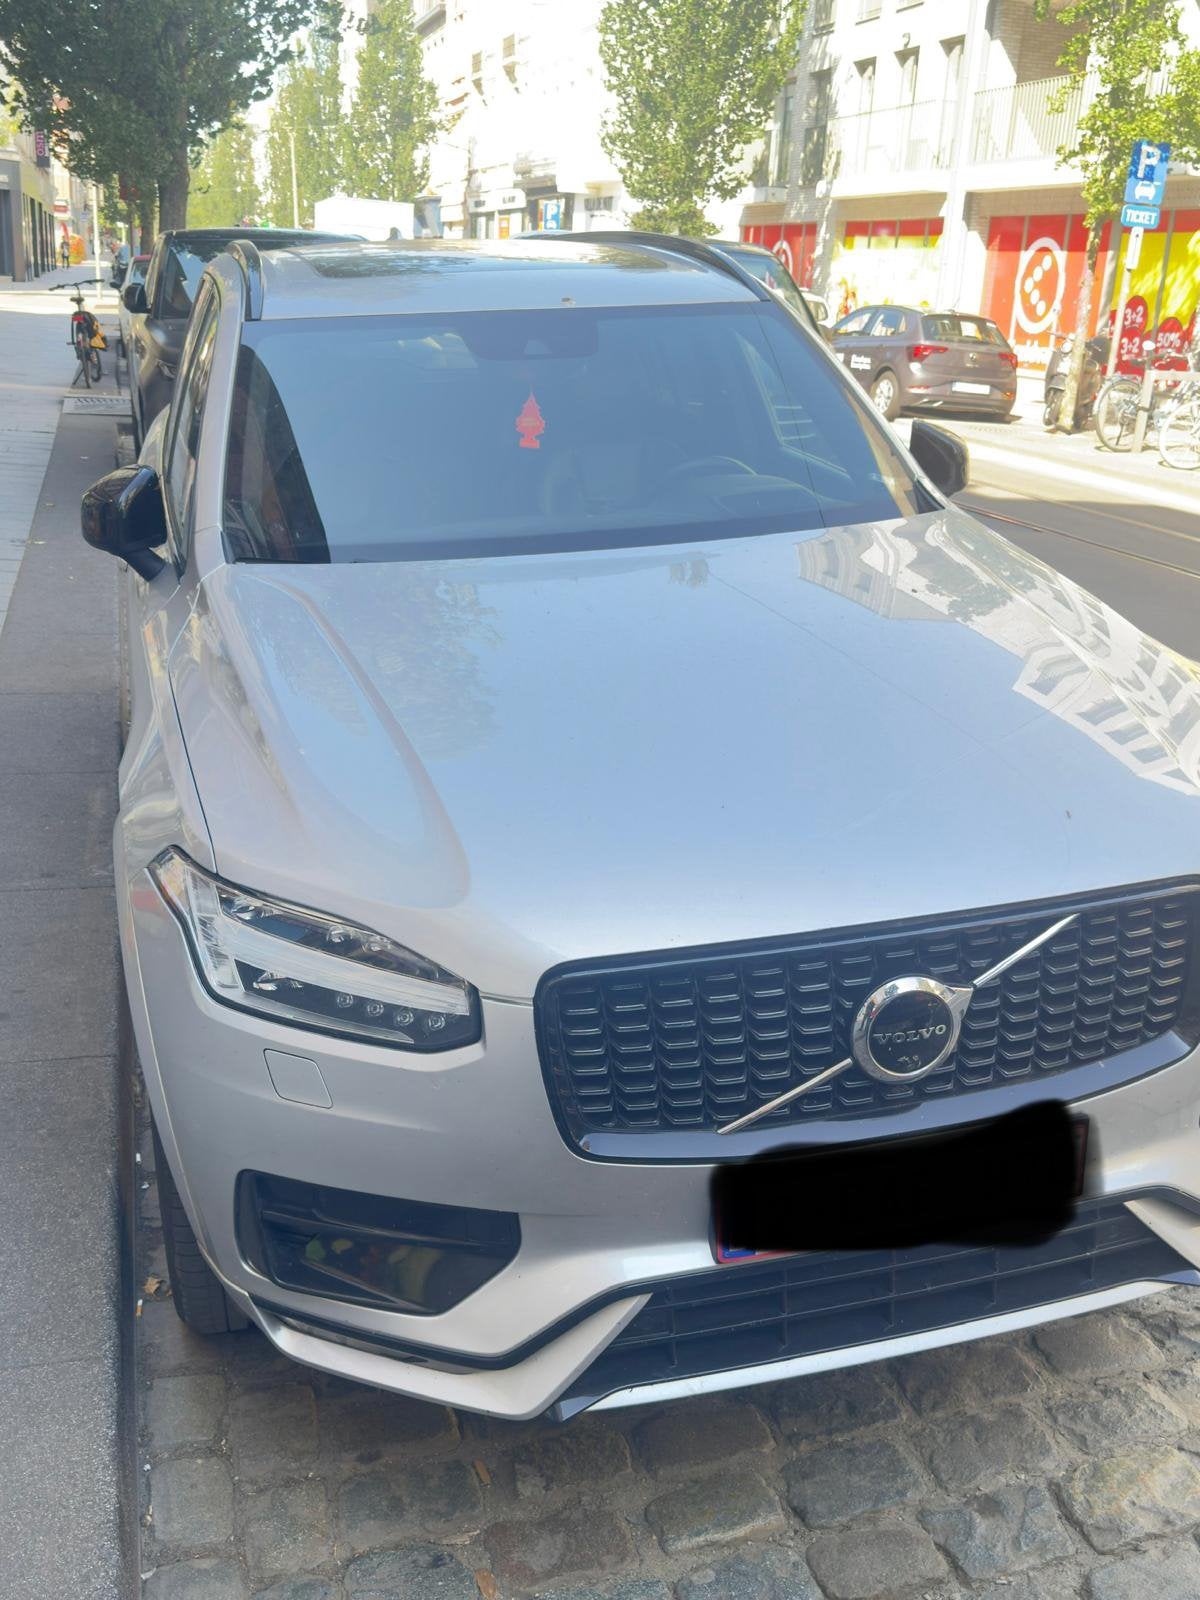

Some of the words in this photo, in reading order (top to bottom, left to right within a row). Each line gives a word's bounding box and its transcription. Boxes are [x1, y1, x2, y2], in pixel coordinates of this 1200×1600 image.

[1138, 144, 1161, 179] P
[1125, 208, 1158, 226] TICKET
[1124, 305, 1144, 325] 3+2
[1120, 336, 1140, 354] 3+2
[1156, 332, 1181, 348] 50%
[872, 1024, 947, 1045] VOLVO
